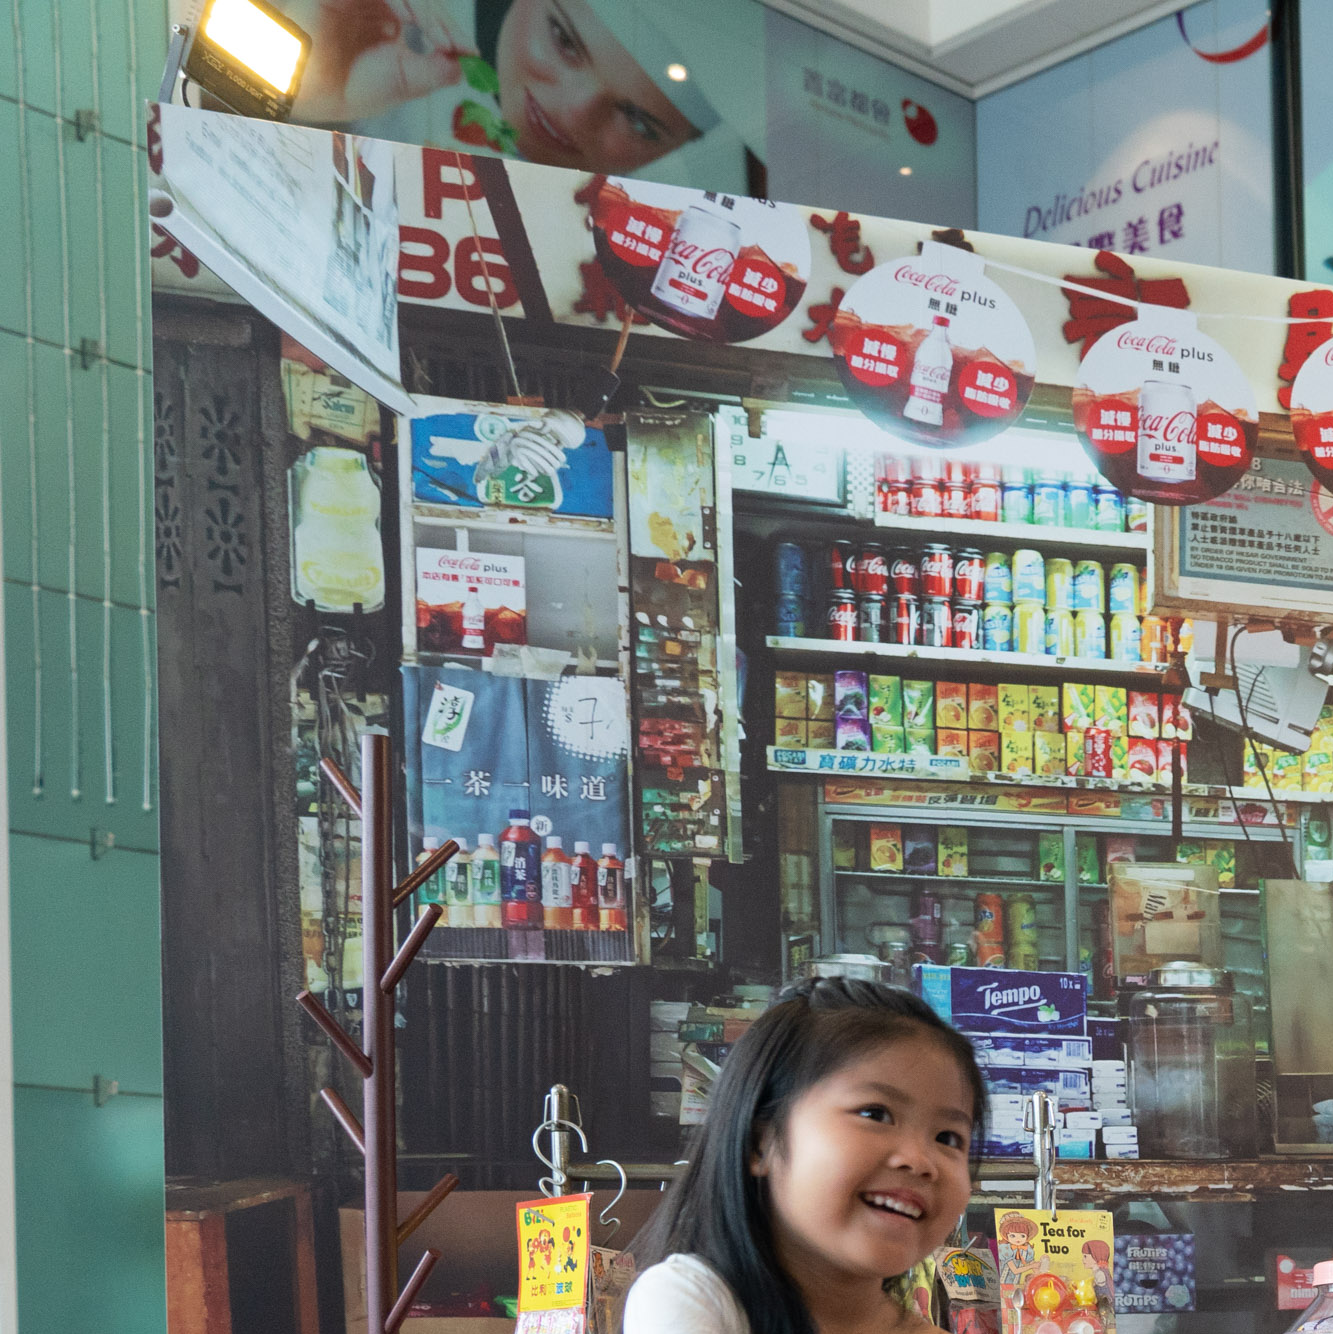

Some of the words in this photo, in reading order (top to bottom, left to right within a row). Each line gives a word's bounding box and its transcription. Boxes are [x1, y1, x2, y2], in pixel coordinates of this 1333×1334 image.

[421, 147, 487, 220] P
[1023, 177, 1123, 239] Delicious
[1132, 140, 1220, 193] Cuisine
[397, 224, 519, 308] 86
[678, 271, 703, 287] plus
[961, 290, 996, 310] plus
[1180, 346, 1214, 362] plus
[1154, 442, 1177, 453] plus
[483, 564, 508, 574] plus
[818, 753, 917, 774] 寶礦力水特
[424, 770, 607, 801] 一茶一味道
[976, 982, 1042, 1010] Tempo
[1040, 1223, 1064, 1238] Tea
[1066, 1225, 1086, 1238] for
[1041, 1239, 1070, 1255] Two
